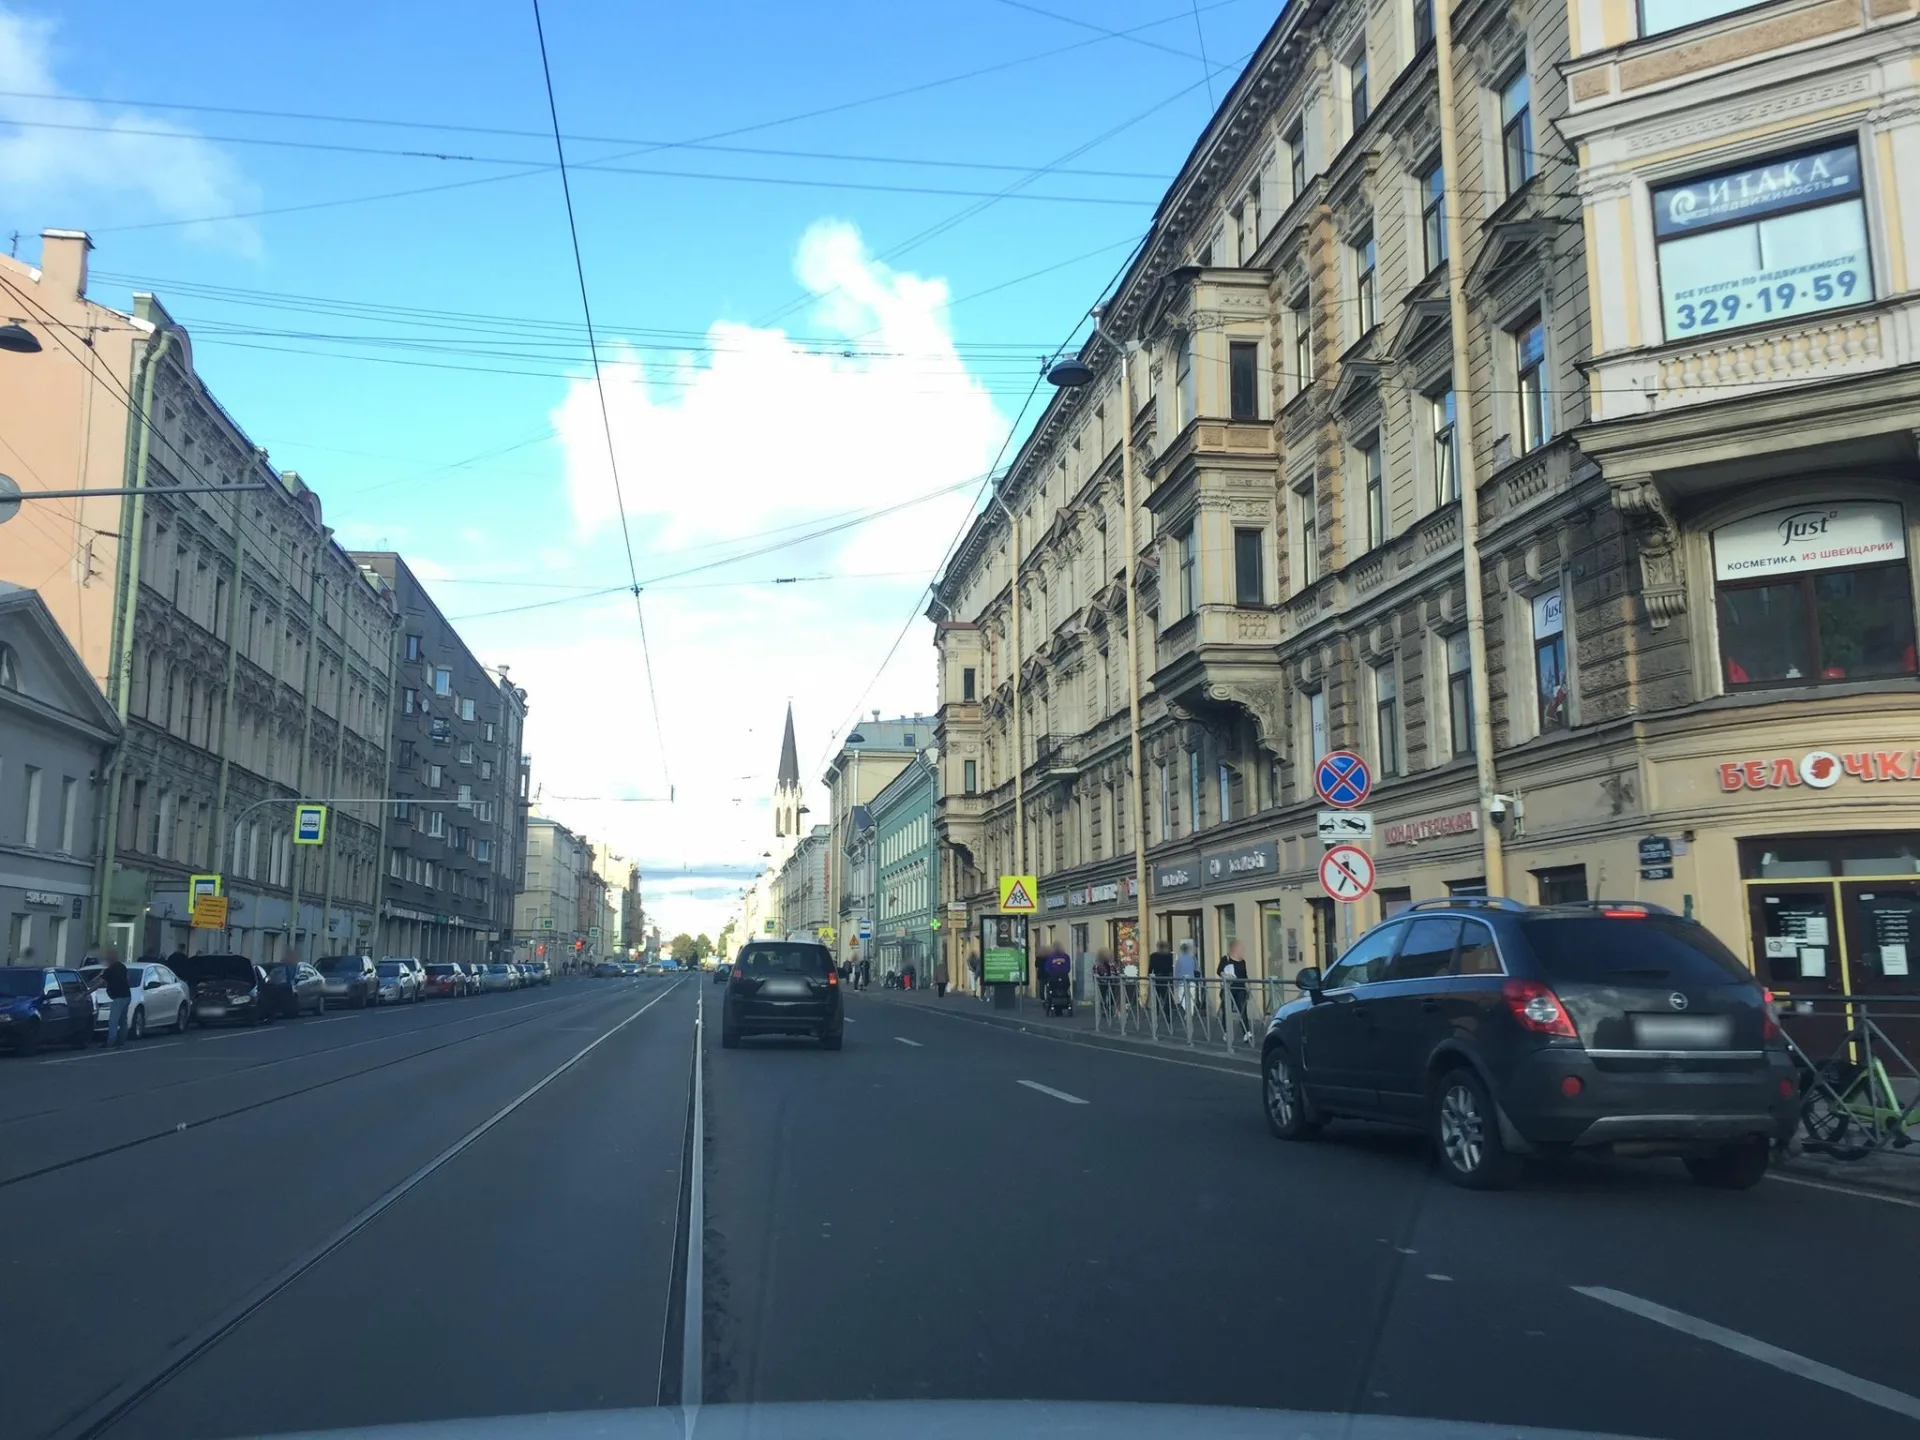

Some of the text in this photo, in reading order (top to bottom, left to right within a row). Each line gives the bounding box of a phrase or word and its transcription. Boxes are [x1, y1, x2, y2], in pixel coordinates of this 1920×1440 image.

[1710, 158, 1829, 204] ИТАКА
[1675, 255, 1856, 300] ВСЕ УСЛУГИ ПО НЕДВИЖИМОСТИ
[1782, 515, 1829, 546] Just
[1727, 541, 1894, 571] КОСМЕТИКА ИЗ ШВЕЙЦАРИИ
